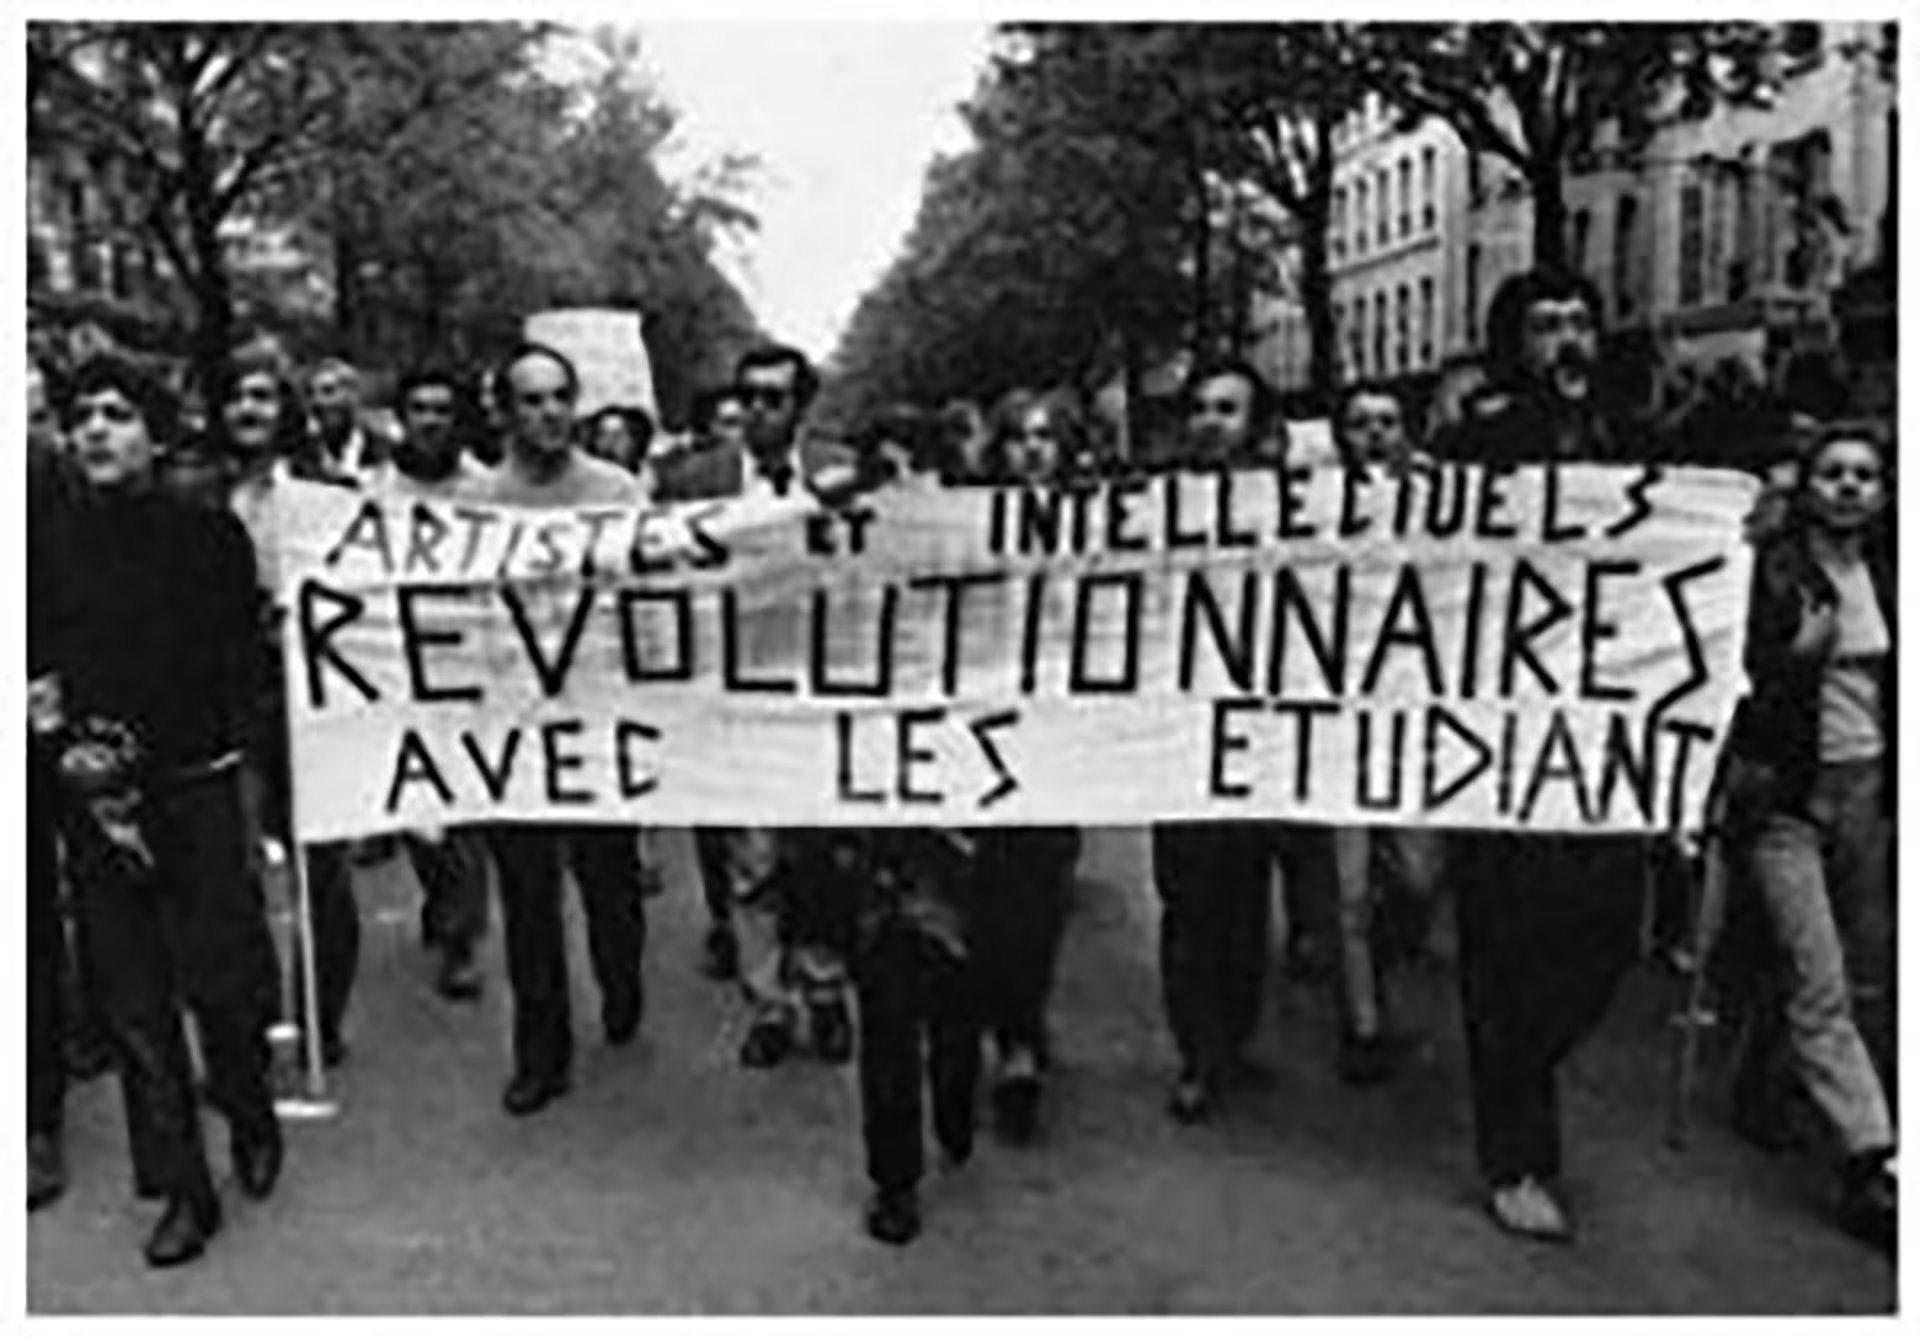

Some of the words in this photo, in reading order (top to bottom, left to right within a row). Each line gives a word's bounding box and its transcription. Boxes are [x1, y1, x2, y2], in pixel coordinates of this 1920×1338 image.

[326, 502, 728, 576] ARTISTES
[806, 508, 874, 554] ET
[300, 556, 1726, 710] REVOLUTIONNAIRES
[386, 716, 660, 812] AVEC
[838, 711, 1019, 806] LES
[1210, 699, 1714, 827] ETUDIANT
